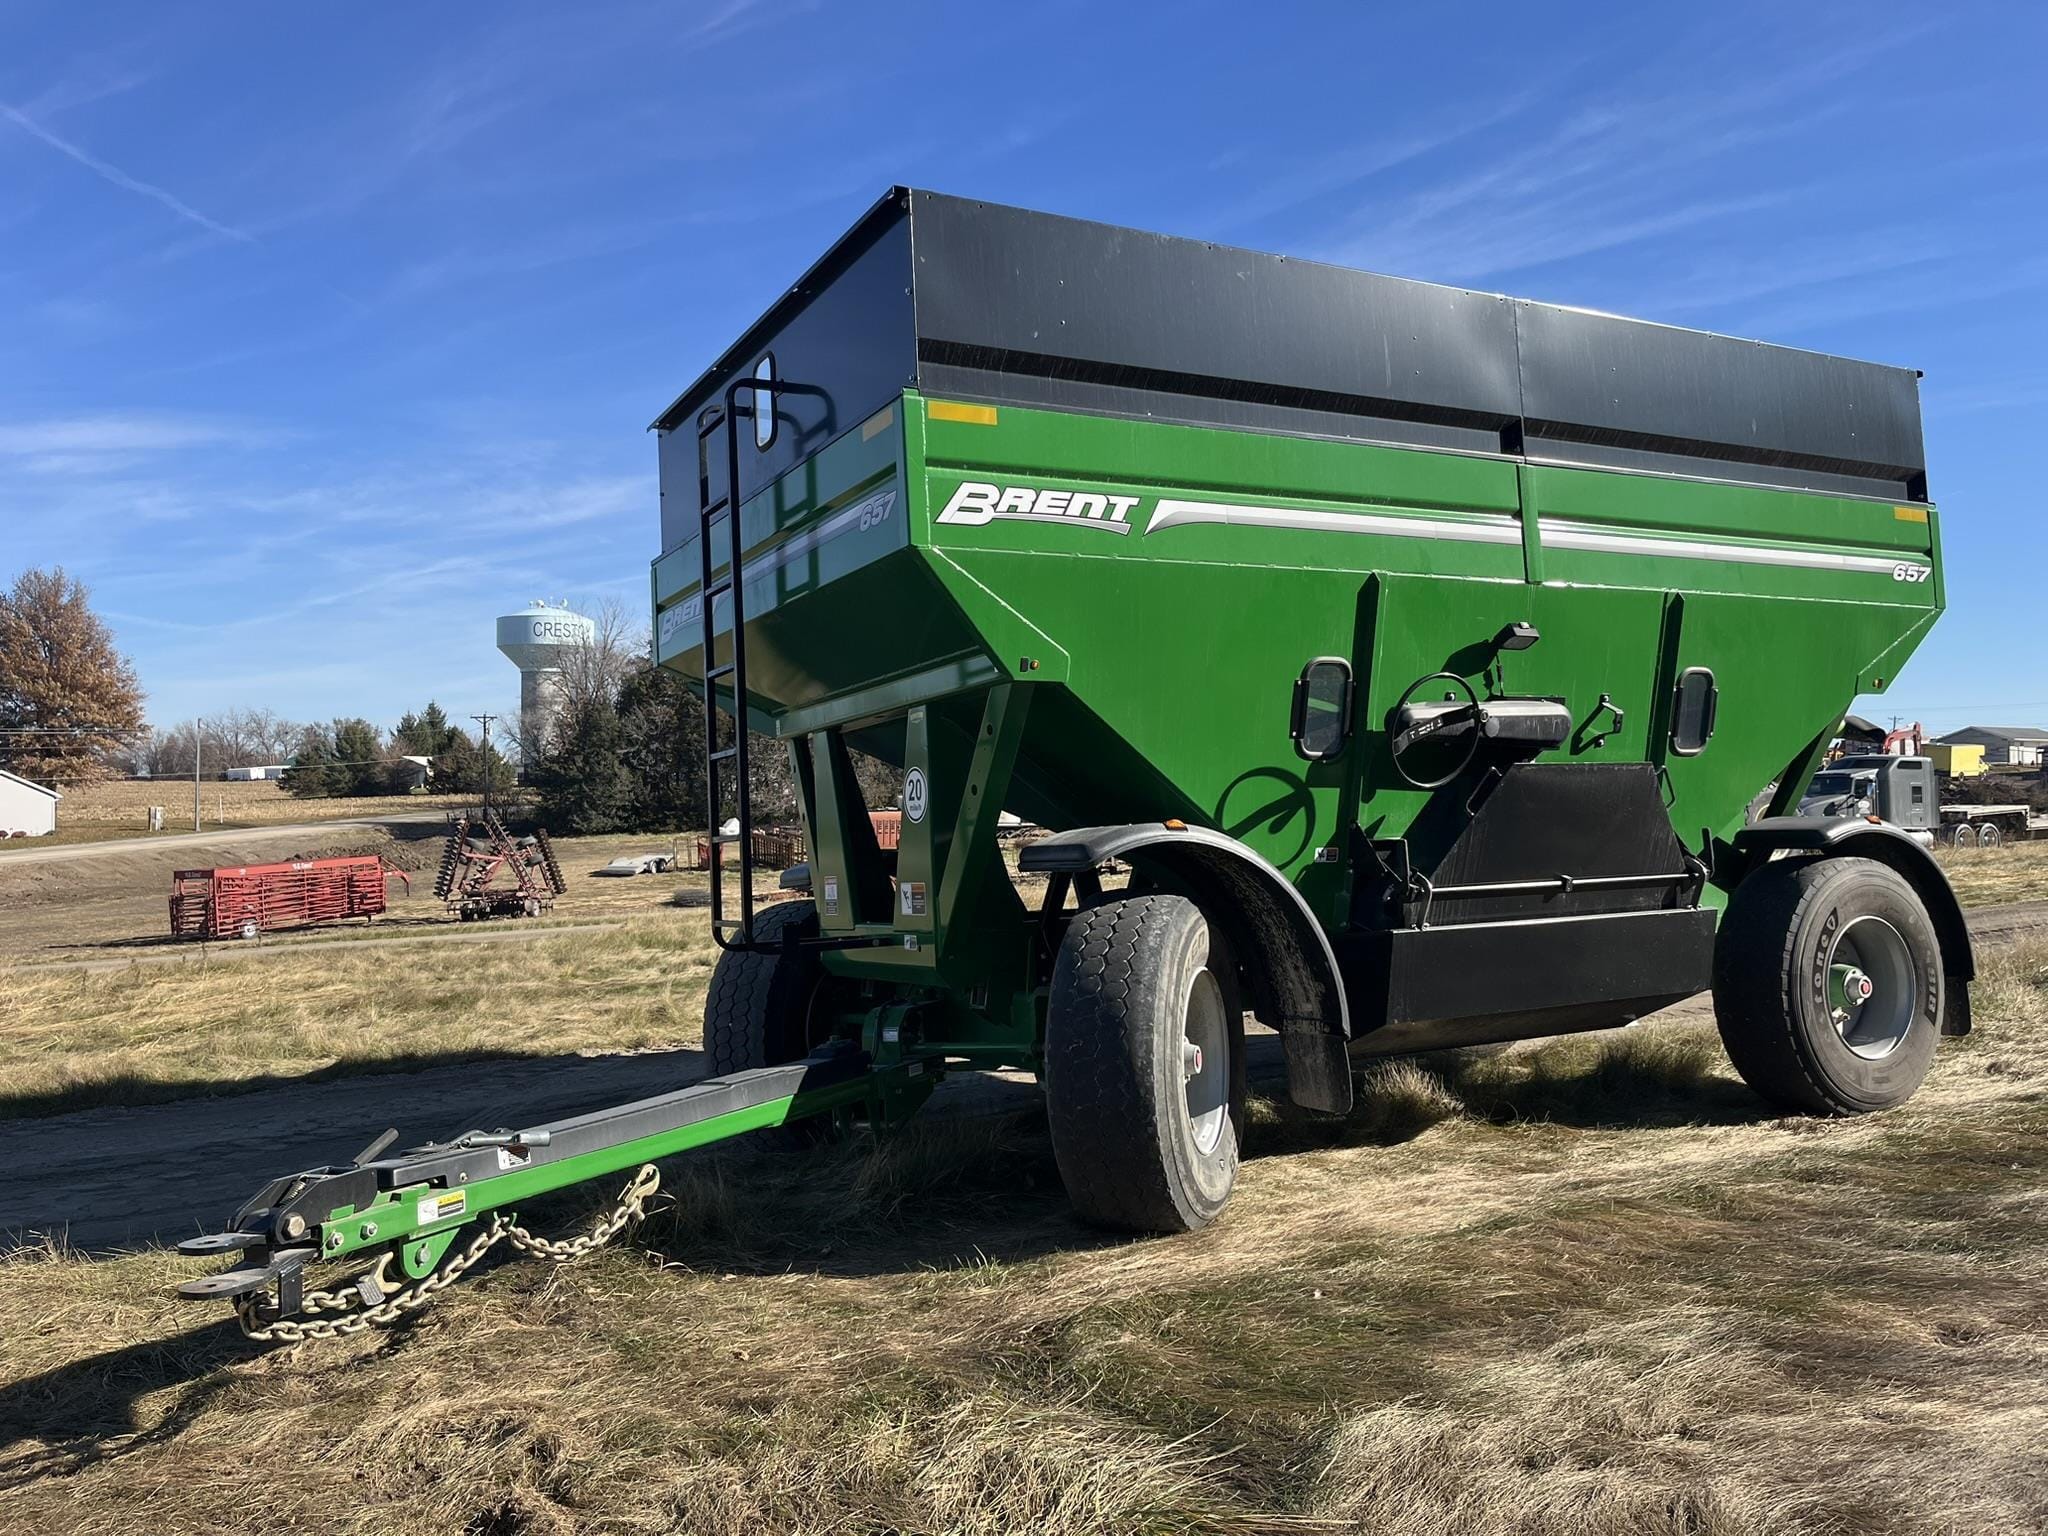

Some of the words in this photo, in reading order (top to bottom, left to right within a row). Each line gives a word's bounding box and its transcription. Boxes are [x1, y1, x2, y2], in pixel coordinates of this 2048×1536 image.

[860, 490, 897, 532] 657
[935, 481, 1141, 526] BRENT
[1892, 564, 1931, 583] 657
[660, 595, 703, 646] BREN
[908, 779, 922, 801] 20
